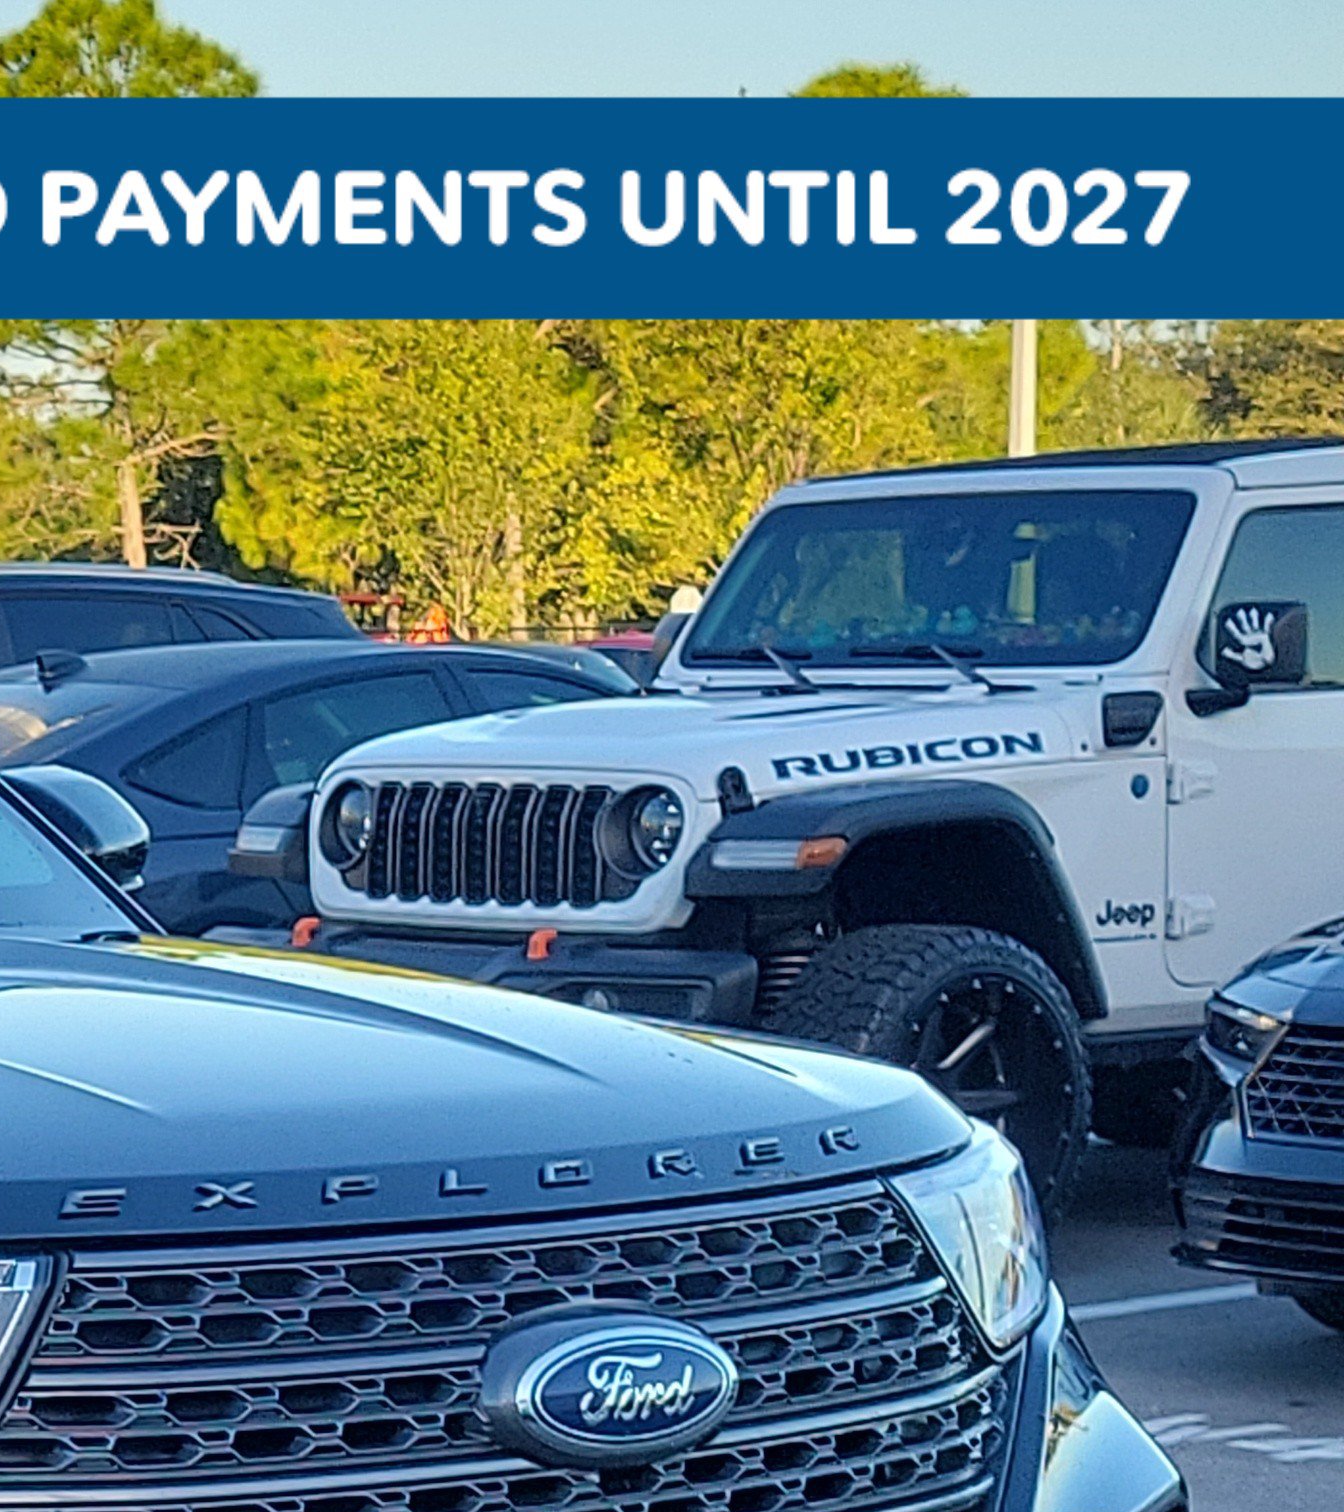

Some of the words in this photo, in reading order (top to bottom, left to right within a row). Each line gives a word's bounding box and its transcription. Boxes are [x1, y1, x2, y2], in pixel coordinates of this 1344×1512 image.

[771, 732, 1044, 780] RUBICON
[1096, 899, 1155, 927] Jeep
[56, 1125, 862, 1219] EXPLORER
[579, 1352, 696, 1426] Ford
